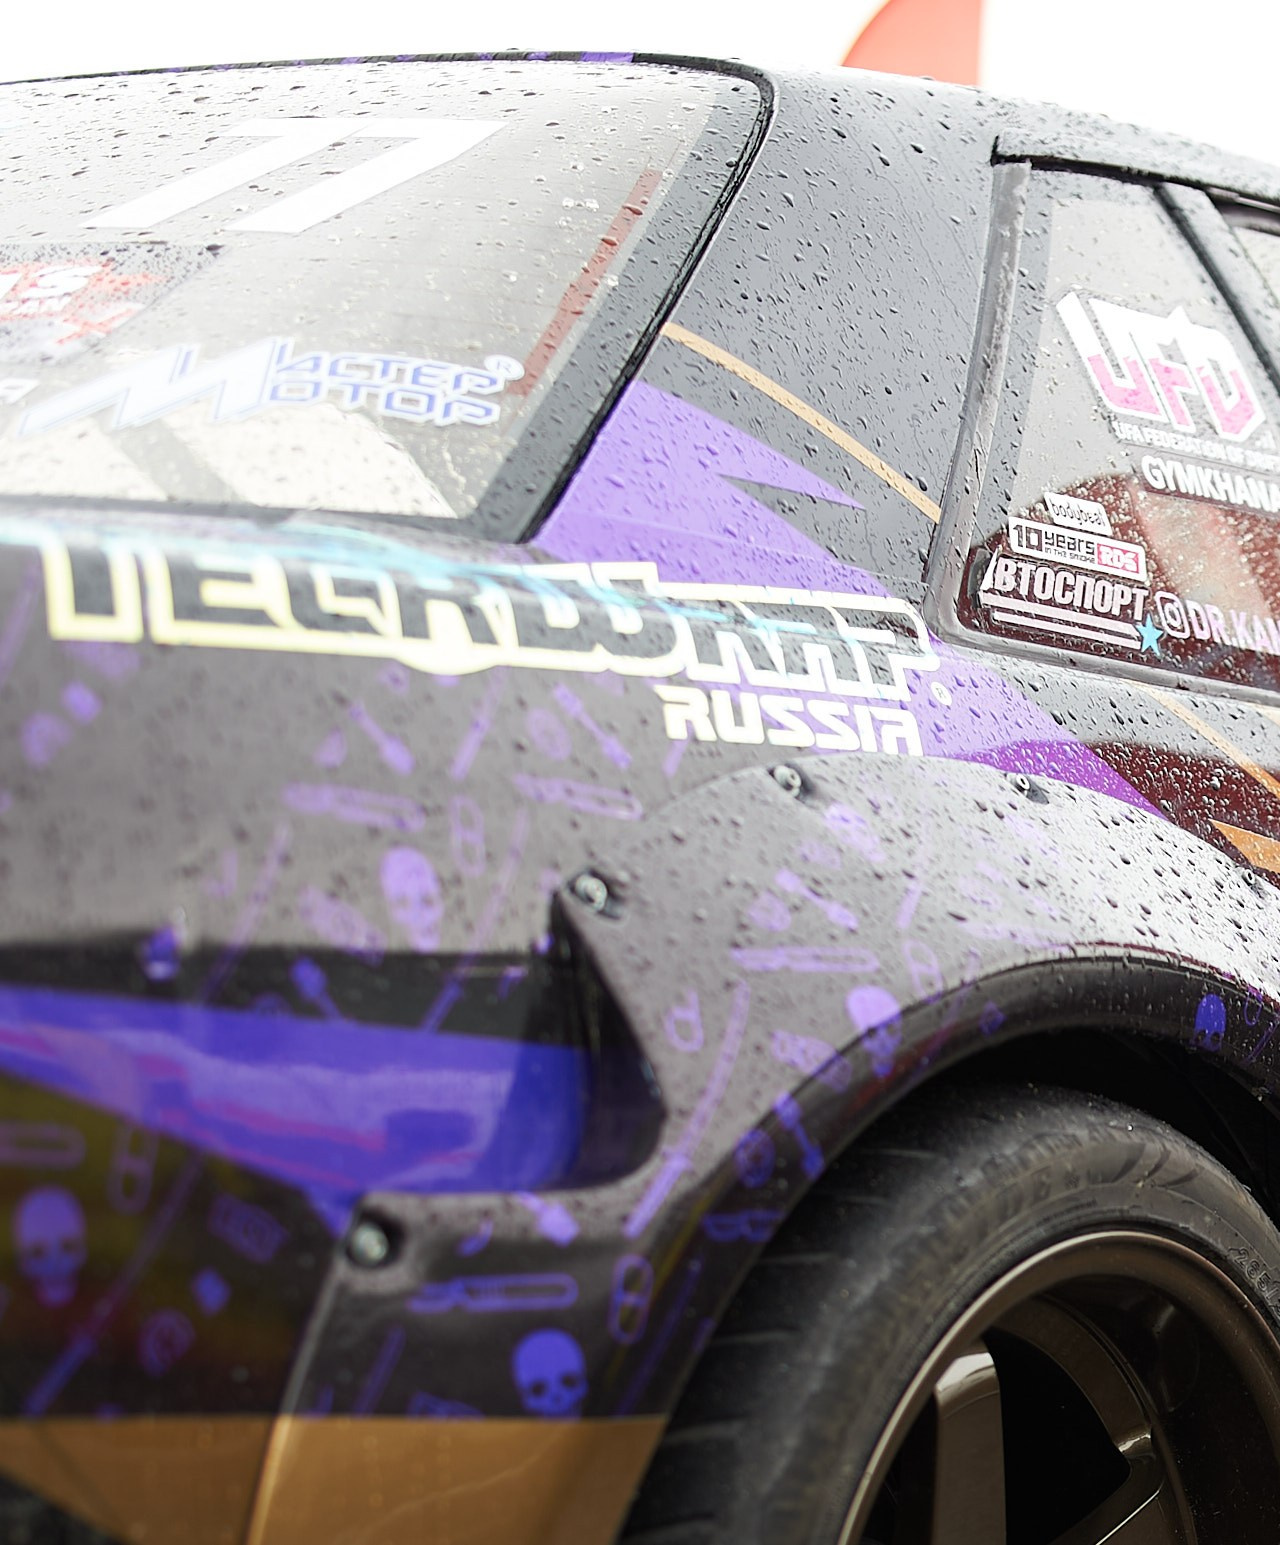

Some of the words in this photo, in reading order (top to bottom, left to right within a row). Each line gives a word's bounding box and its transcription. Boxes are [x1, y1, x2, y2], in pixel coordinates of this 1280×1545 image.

[80, 117, 508, 232] 77
[1012, 524, 1043, 552] 10
[1099, 545, 1140, 575] RDS
[653, 684, 925, 757] RUSSIA
